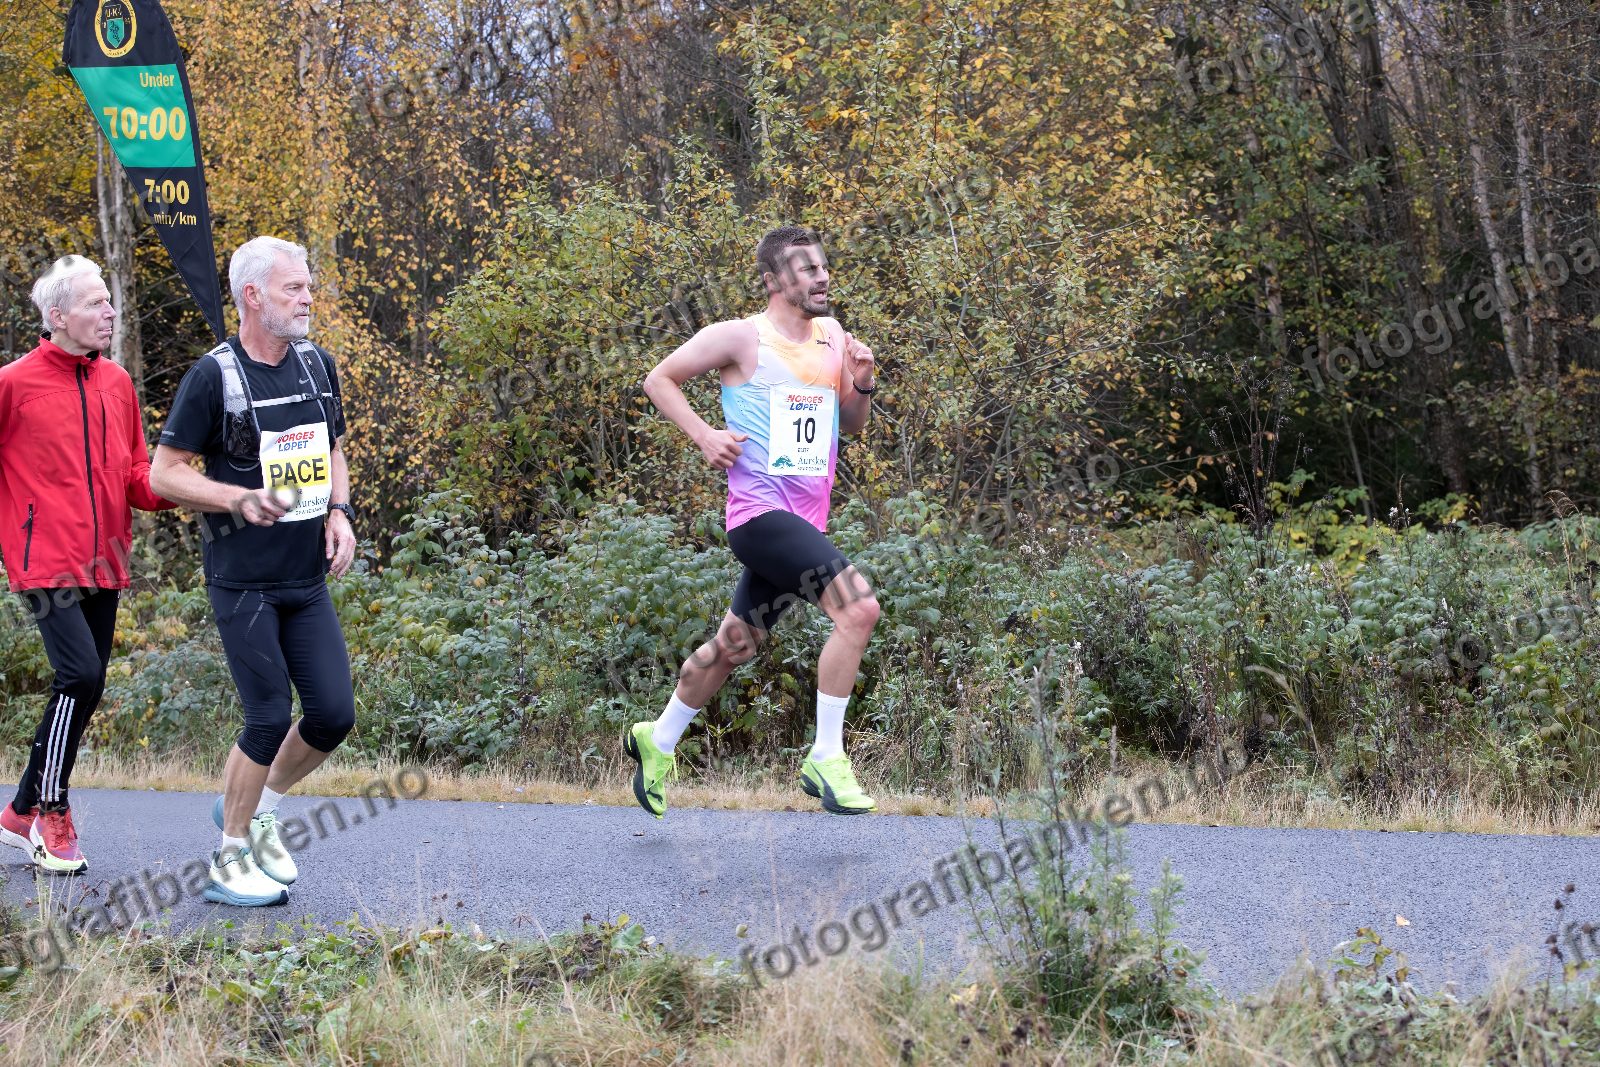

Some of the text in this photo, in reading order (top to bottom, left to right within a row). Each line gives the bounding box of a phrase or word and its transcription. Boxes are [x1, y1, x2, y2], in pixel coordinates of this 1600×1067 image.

[140, 72, 175, 87] Under
[103, 106, 186, 141] 70:00
[144, 178, 190, 205] 7:00
[153, 211, 197, 227] min/km
[787, 394, 824, 404] NORGES
[789, 402, 818, 411] LØPET
[793, 417, 816, 444] 10
[278, 439, 309, 452] LØPET
[797, 456, 827, 468] Aurskog
[269, 457, 326, 488] PACE
